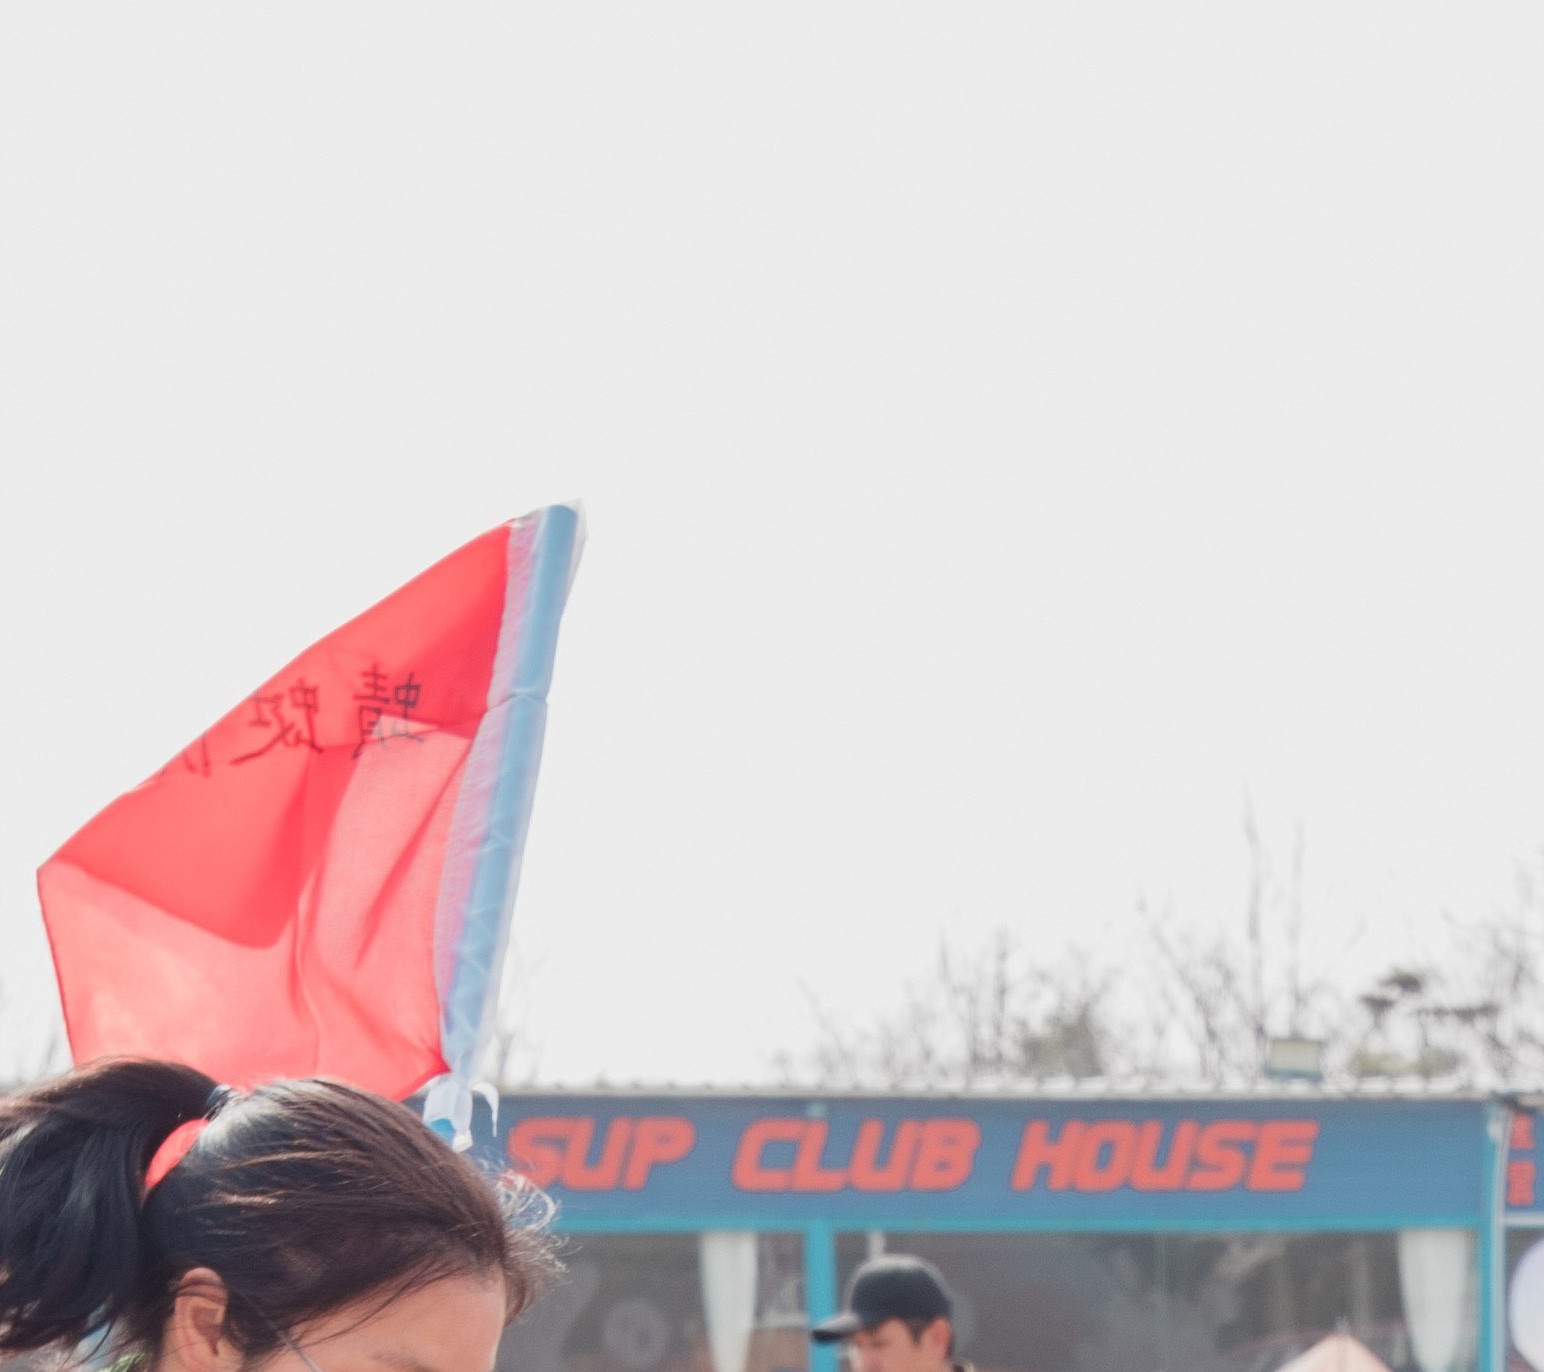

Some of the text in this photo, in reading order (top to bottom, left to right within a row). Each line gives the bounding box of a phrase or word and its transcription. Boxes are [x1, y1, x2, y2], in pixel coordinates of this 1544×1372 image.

[507, 1116, 1319, 1192] SUP CLUB HOUSE
